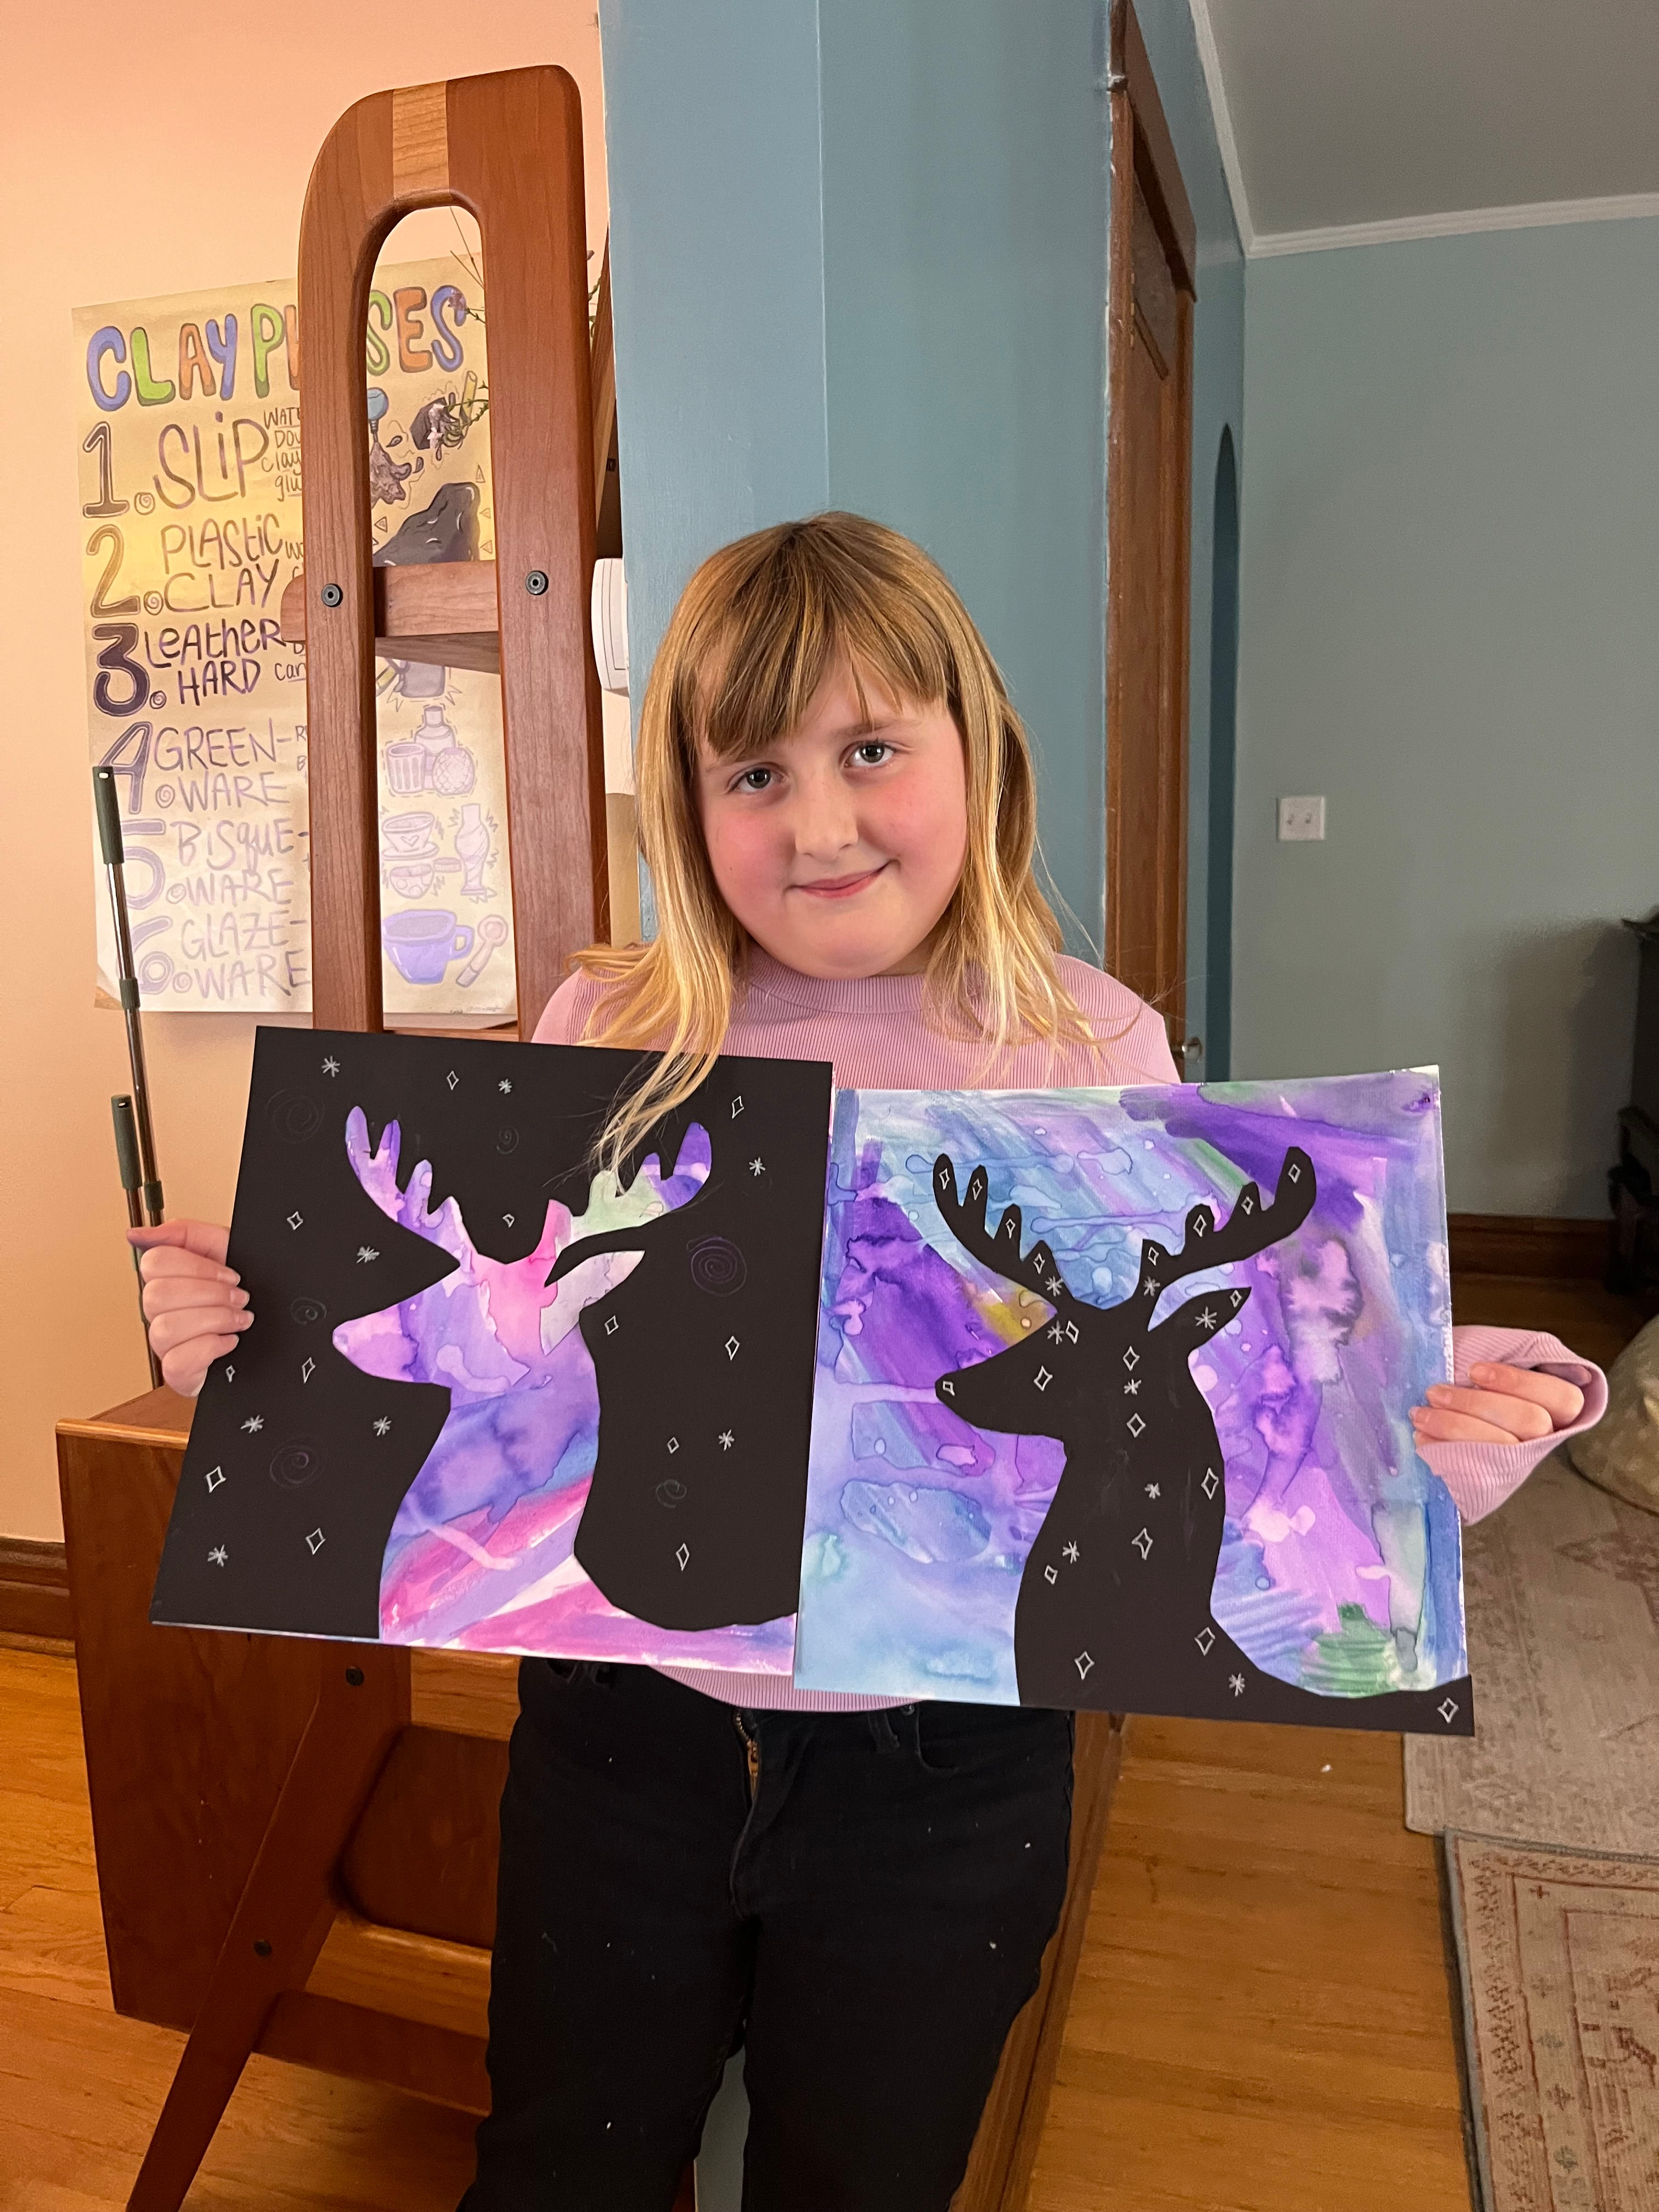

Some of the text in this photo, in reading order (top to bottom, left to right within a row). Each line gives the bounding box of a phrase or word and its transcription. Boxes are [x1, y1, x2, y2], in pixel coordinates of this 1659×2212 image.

[87, 285, 466, 411] CLAY PSES
[163, 558, 279, 612] CLAY
[177, 660, 261, 707] HARD
[179, 772, 290, 812] WARE
[185, 868, 294, 907] WARE
[194, 950, 312, 1001] WARE
